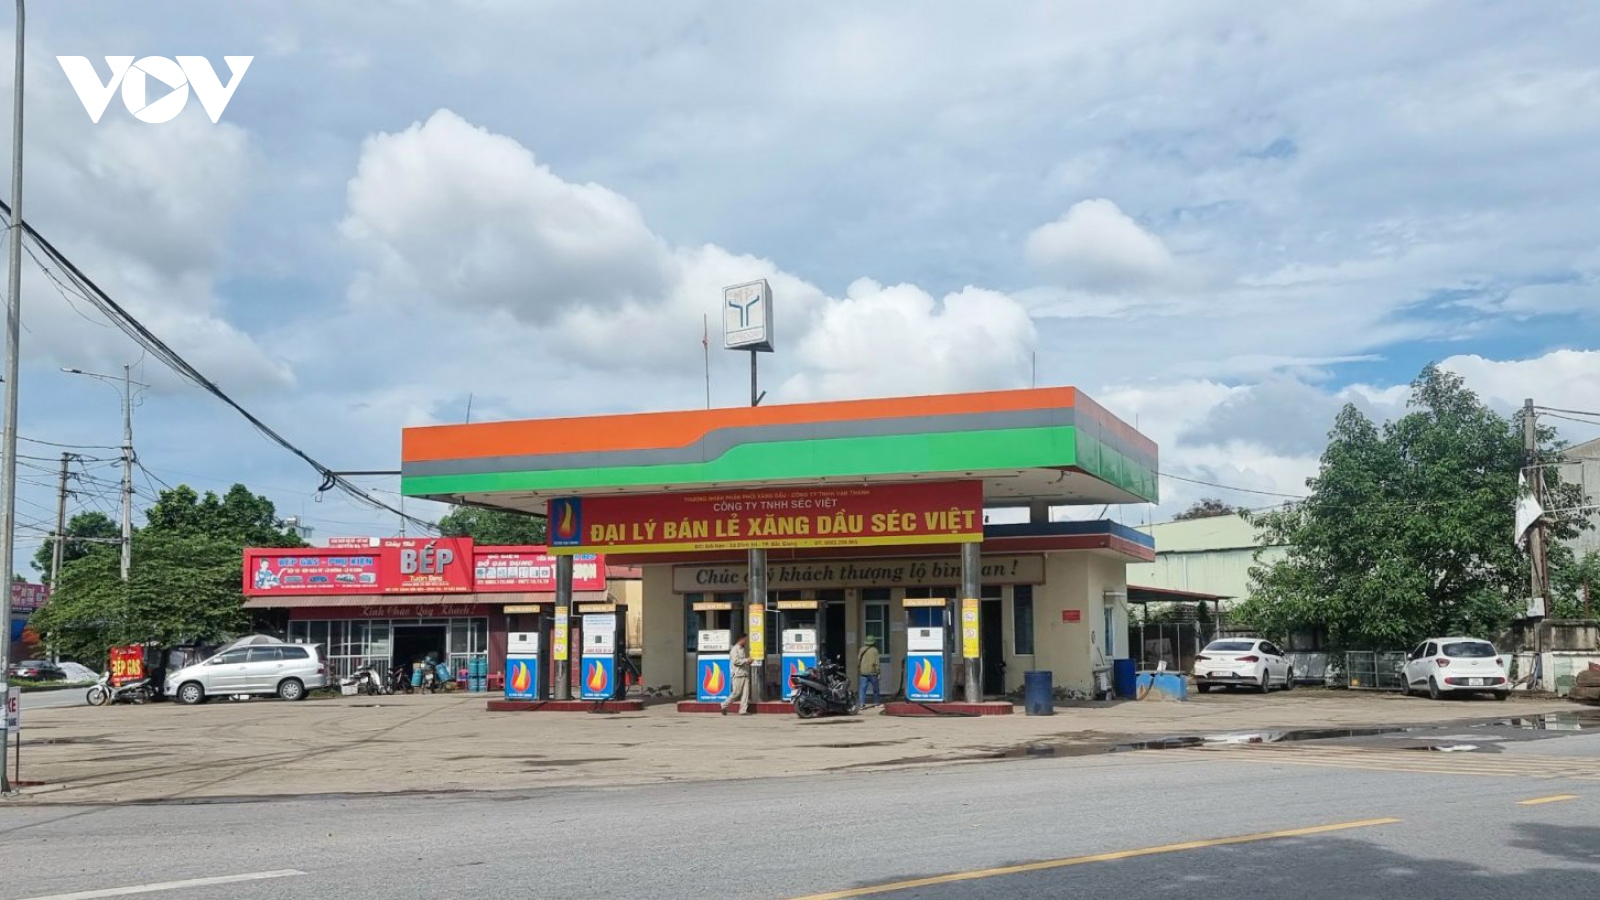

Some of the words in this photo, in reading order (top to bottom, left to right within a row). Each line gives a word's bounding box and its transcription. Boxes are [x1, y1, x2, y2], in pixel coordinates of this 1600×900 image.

[713, 500, 743, 512] CÔNG
[745, 501, 757, 511] TY
[760, 500, 788, 511] TNHH
[791, 497, 812, 509] SÉC
[814, 497, 838, 509] VIỆT
[590, 523, 626, 545] ĐẠI
[633, 519, 657, 541] LÝ
[663, 517, 708, 540] BÁN
[716, 513, 740, 537] LẺ
[748, 513, 810, 536] XĂNG
[817, 508, 863, 534] DẦU
[871, 509, 917, 533] SÉC
[924, 506, 976, 534] VIỆT
[300, 556, 320, 567] GAS
[400, 540, 454, 574] BẾP
[696, 567, 739, 584] Chúc
[779, 565, 834, 582] khách
[840, 562, 905, 585] thượng
[909, 562, 928, 583] lộ
[932, 561, 962, 578] bìn
[981, 564, 1006, 576] an
[1011, 559, 1019, 575] !
